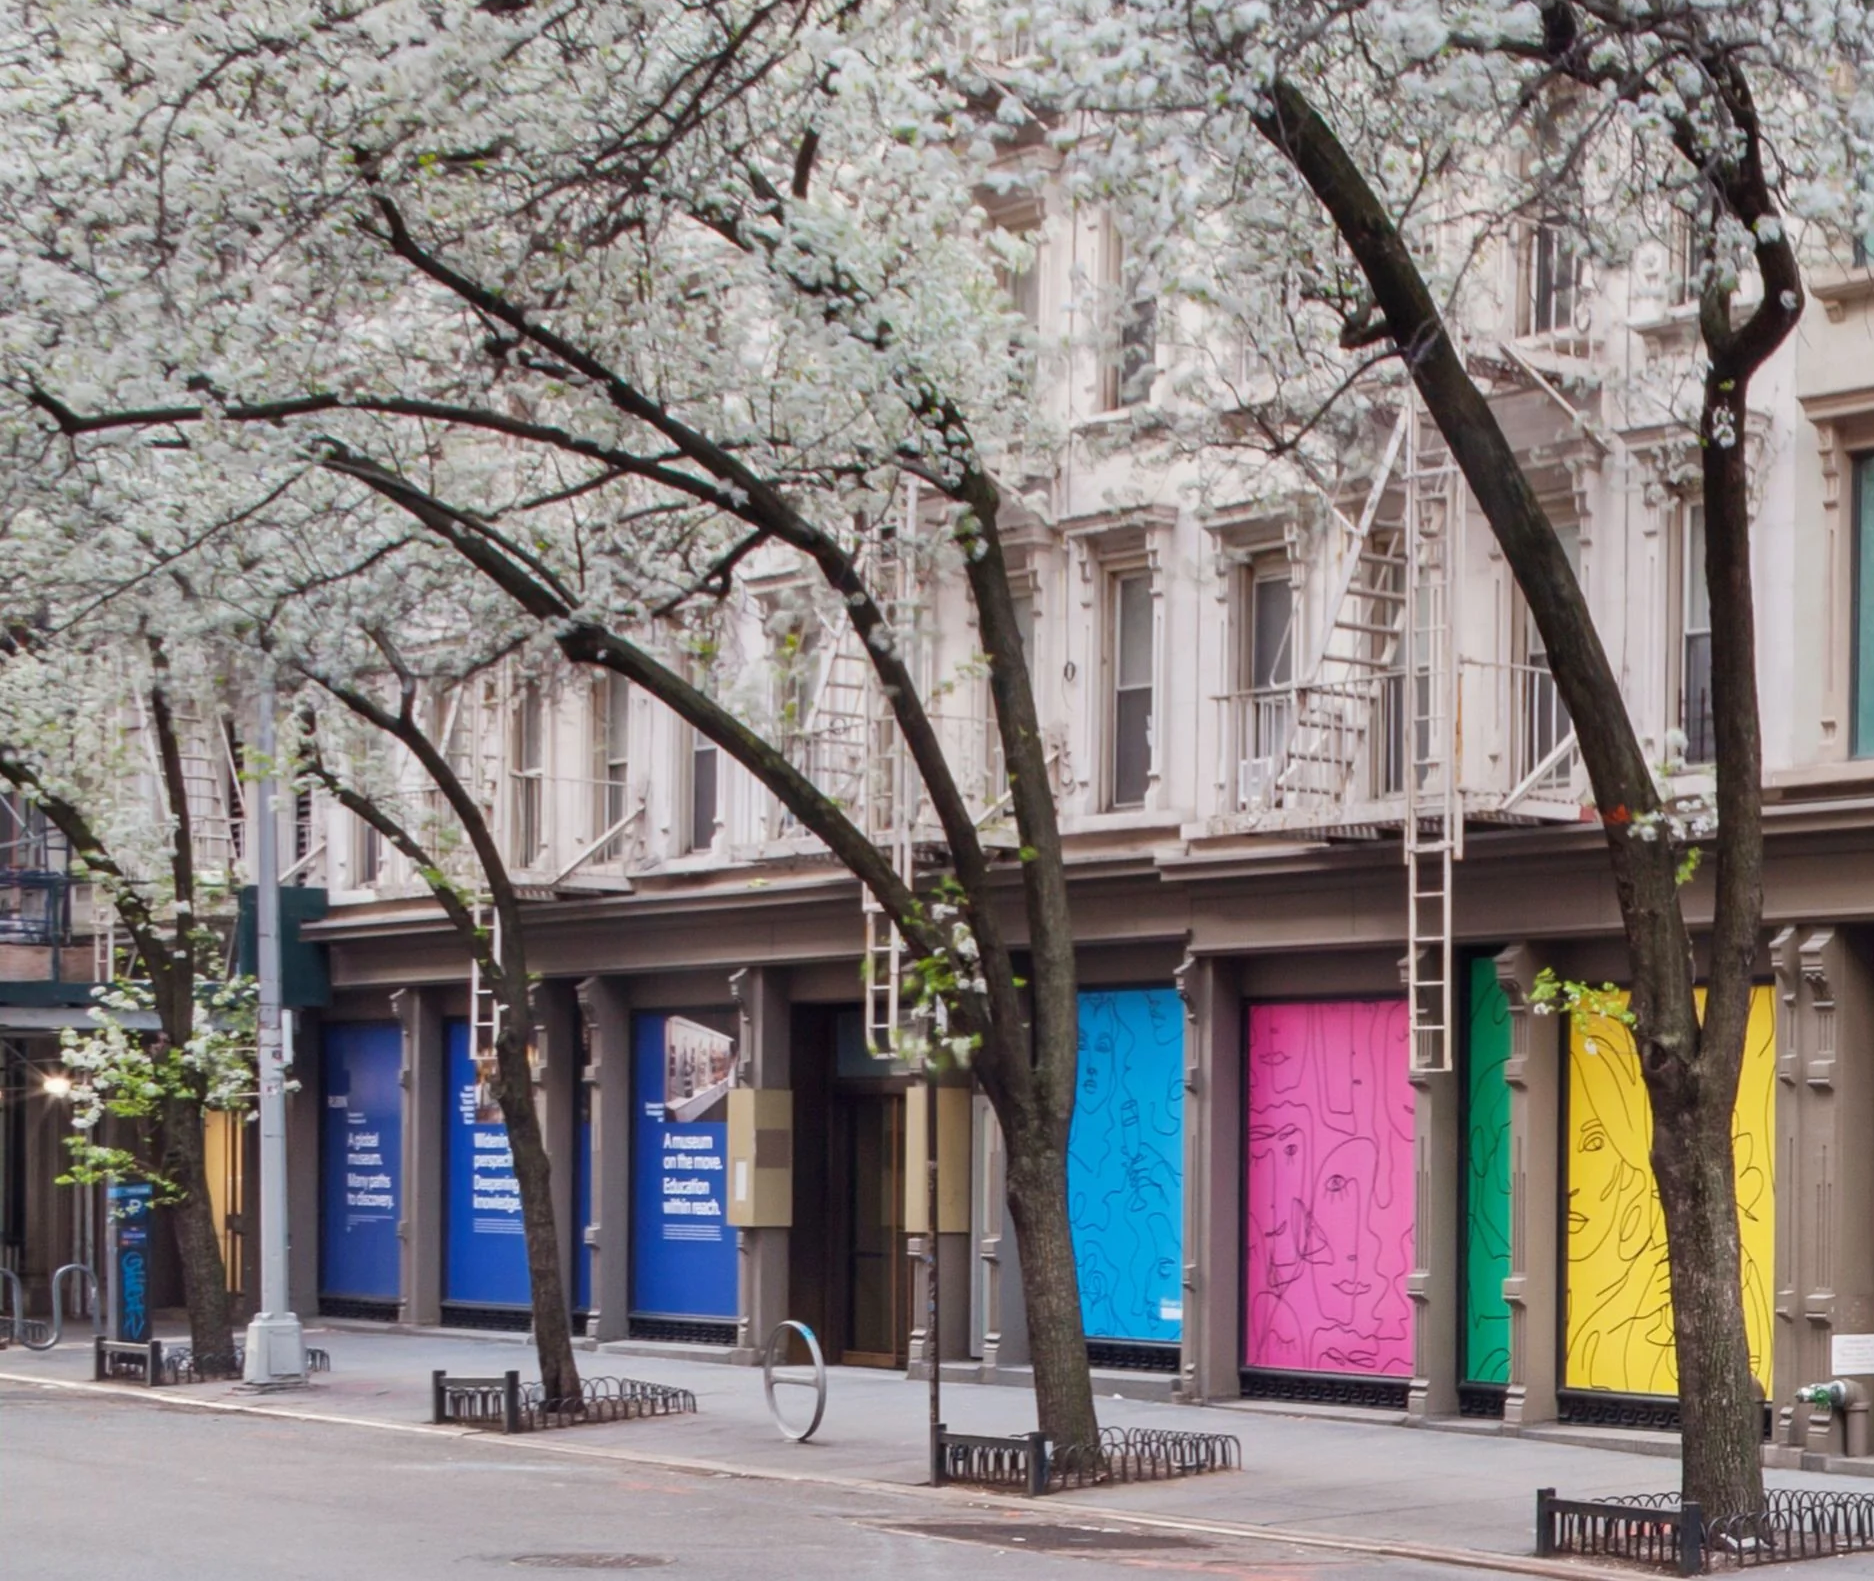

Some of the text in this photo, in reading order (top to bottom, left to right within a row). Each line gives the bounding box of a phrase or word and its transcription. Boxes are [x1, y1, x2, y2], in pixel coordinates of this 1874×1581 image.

[672, 1135, 713, 1150] museum
[663, 1155, 676, 1169] on
[677, 1153, 693, 1169] the
[663, 1177, 710, 1195] Education
